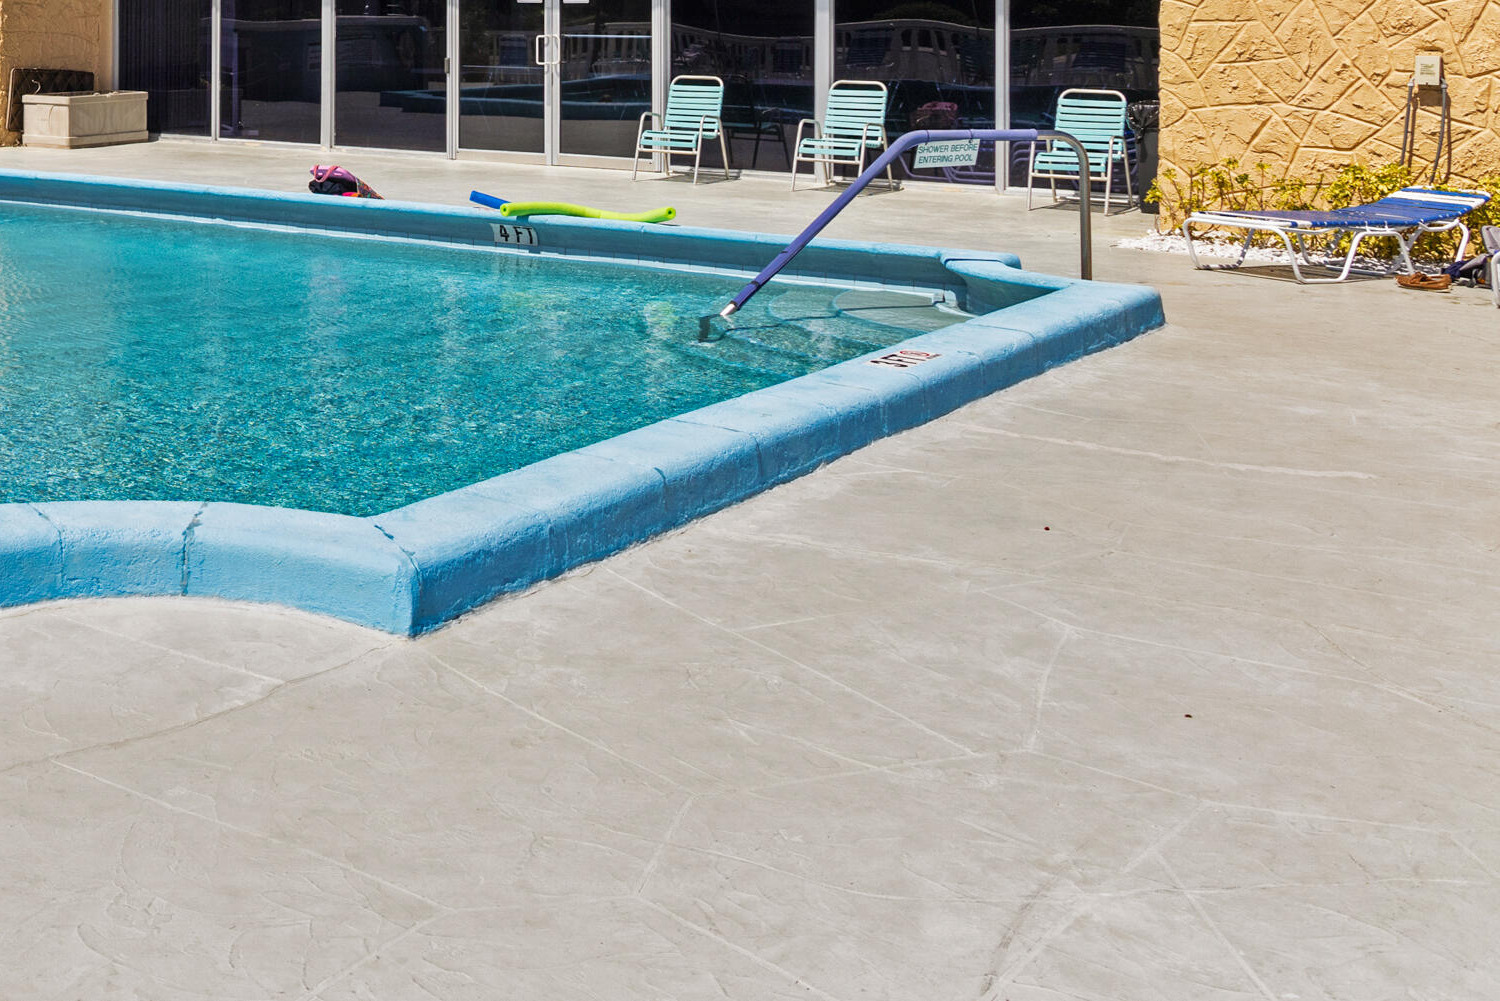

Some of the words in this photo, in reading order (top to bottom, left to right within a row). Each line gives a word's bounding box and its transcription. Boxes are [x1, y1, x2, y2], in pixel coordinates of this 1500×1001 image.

[918, 145, 949, 153] SHOWER
[951, 143, 978, 152] BEFORE
[919, 155, 953, 164] ENTERING
[955, 154, 973, 162] POOL
[500, 224, 509, 241] 4
[513, 226, 533, 244] FT
